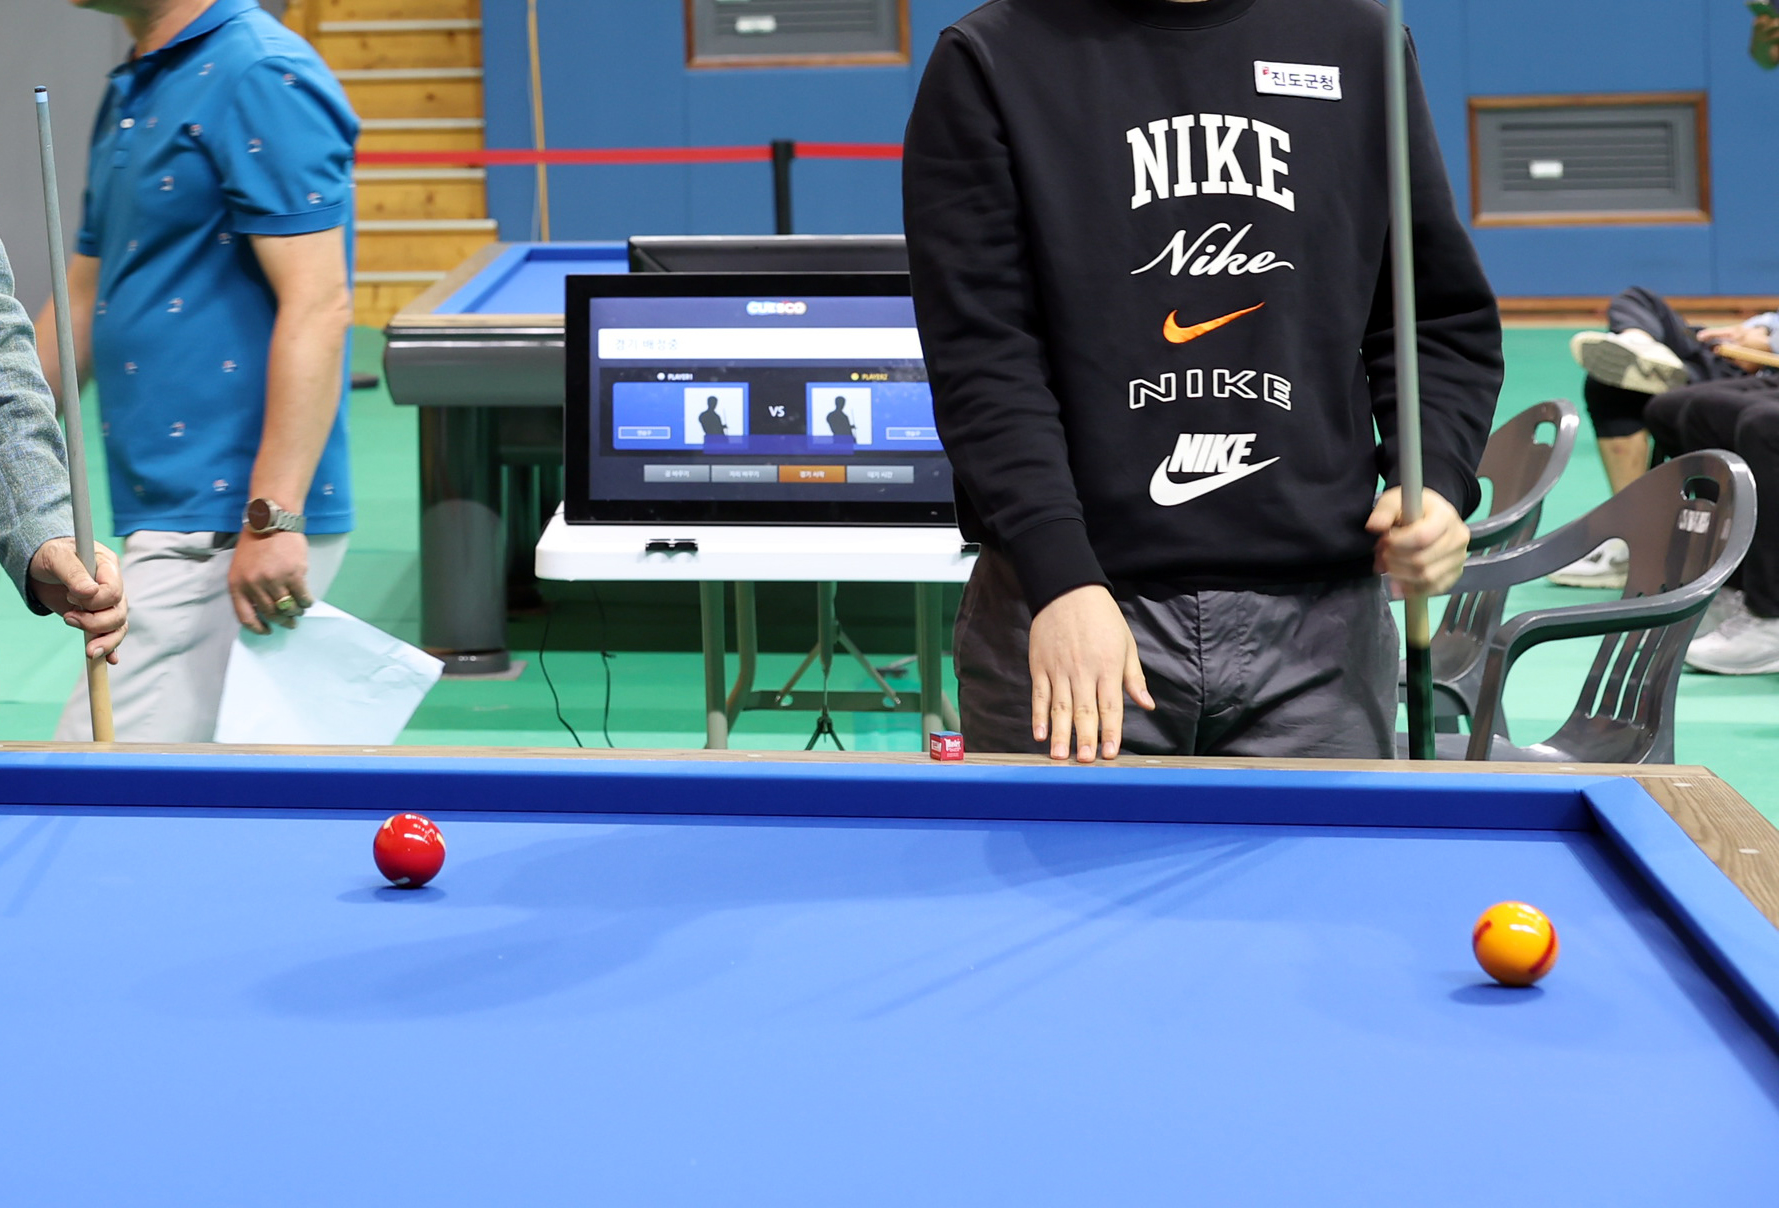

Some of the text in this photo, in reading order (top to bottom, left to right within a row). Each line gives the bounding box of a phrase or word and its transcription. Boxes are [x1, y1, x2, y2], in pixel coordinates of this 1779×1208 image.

[1271, 71, 1334, 91] 진도군청
[1126, 113, 1295, 212] NIKE
[1130, 222, 1295, 277] Nike
[667, 372, 694, 381] PLAYER1
[861, 373, 889, 381] PLAYER2
[1129, 368, 1293, 411] NIKE
[768, 405, 786, 418] VS
[1167, 432, 1258, 473] NIKE
